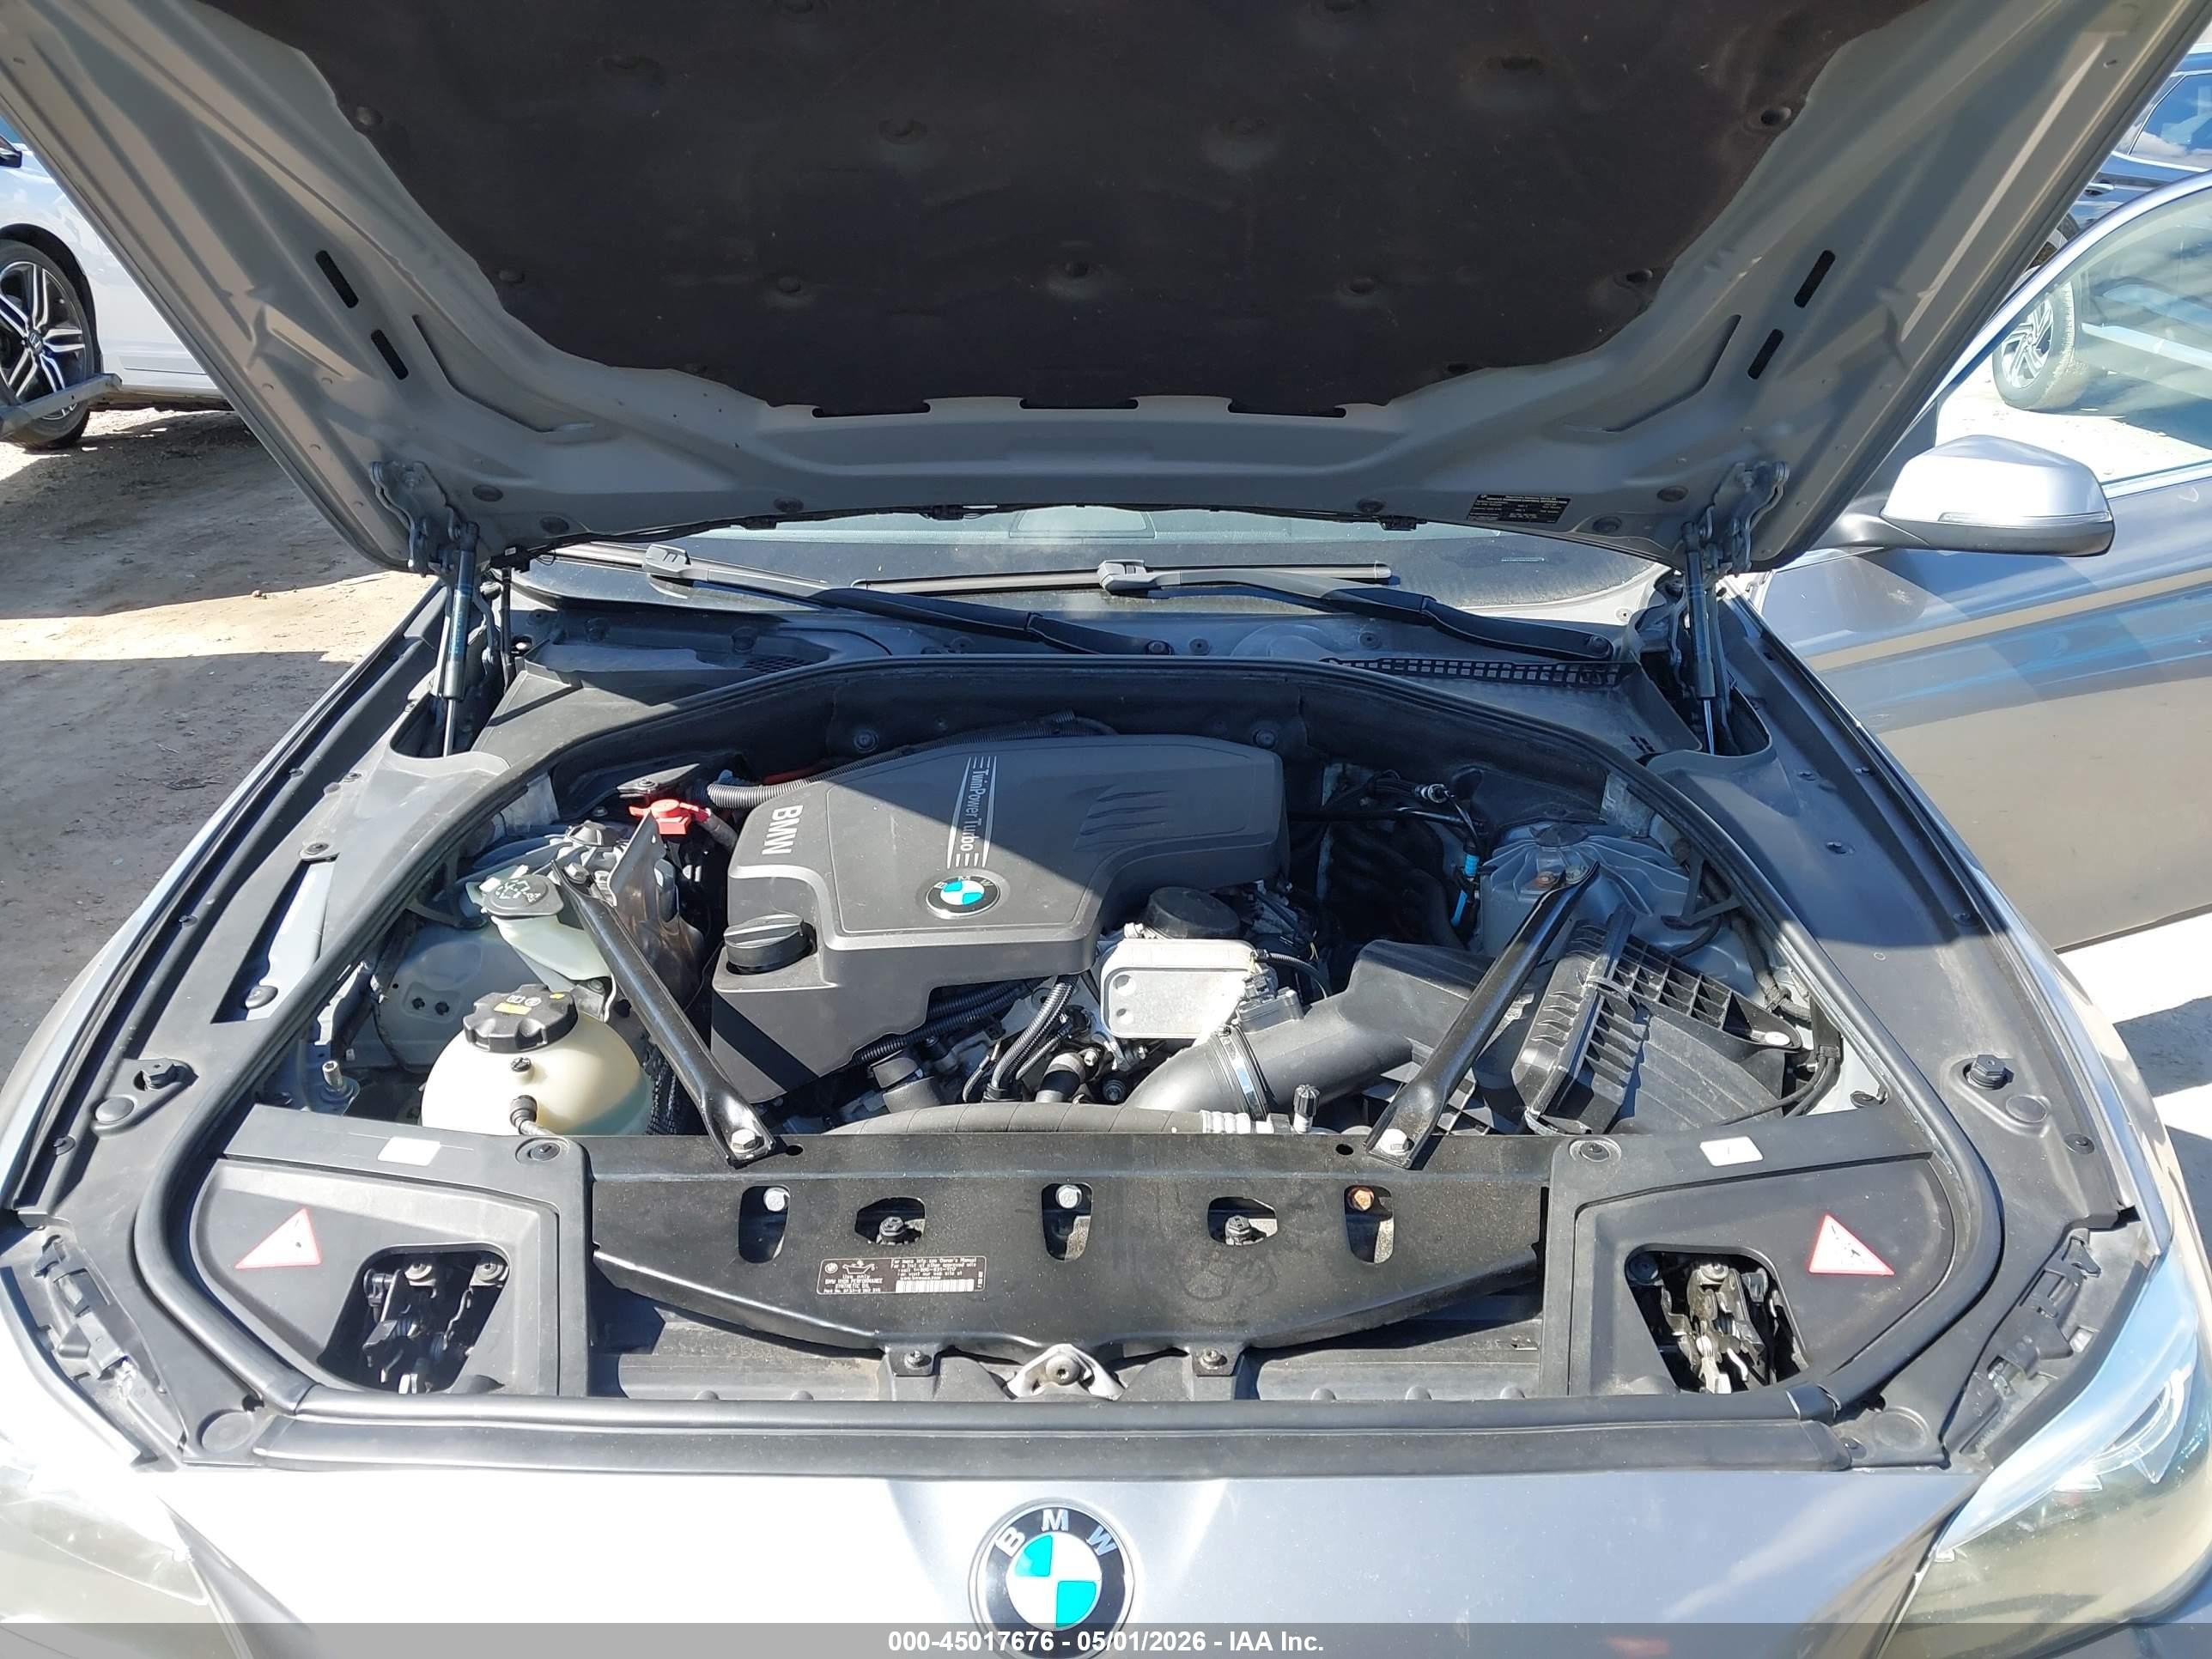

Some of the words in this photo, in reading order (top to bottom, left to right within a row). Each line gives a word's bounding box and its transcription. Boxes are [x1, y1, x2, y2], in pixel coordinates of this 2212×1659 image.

[967, 769, 988, 817] TwinPower
[762, 805, 804, 854] BMW
[960, 818, 982, 852] Turbo
[994, 1509, 1117, 1559] BMW
